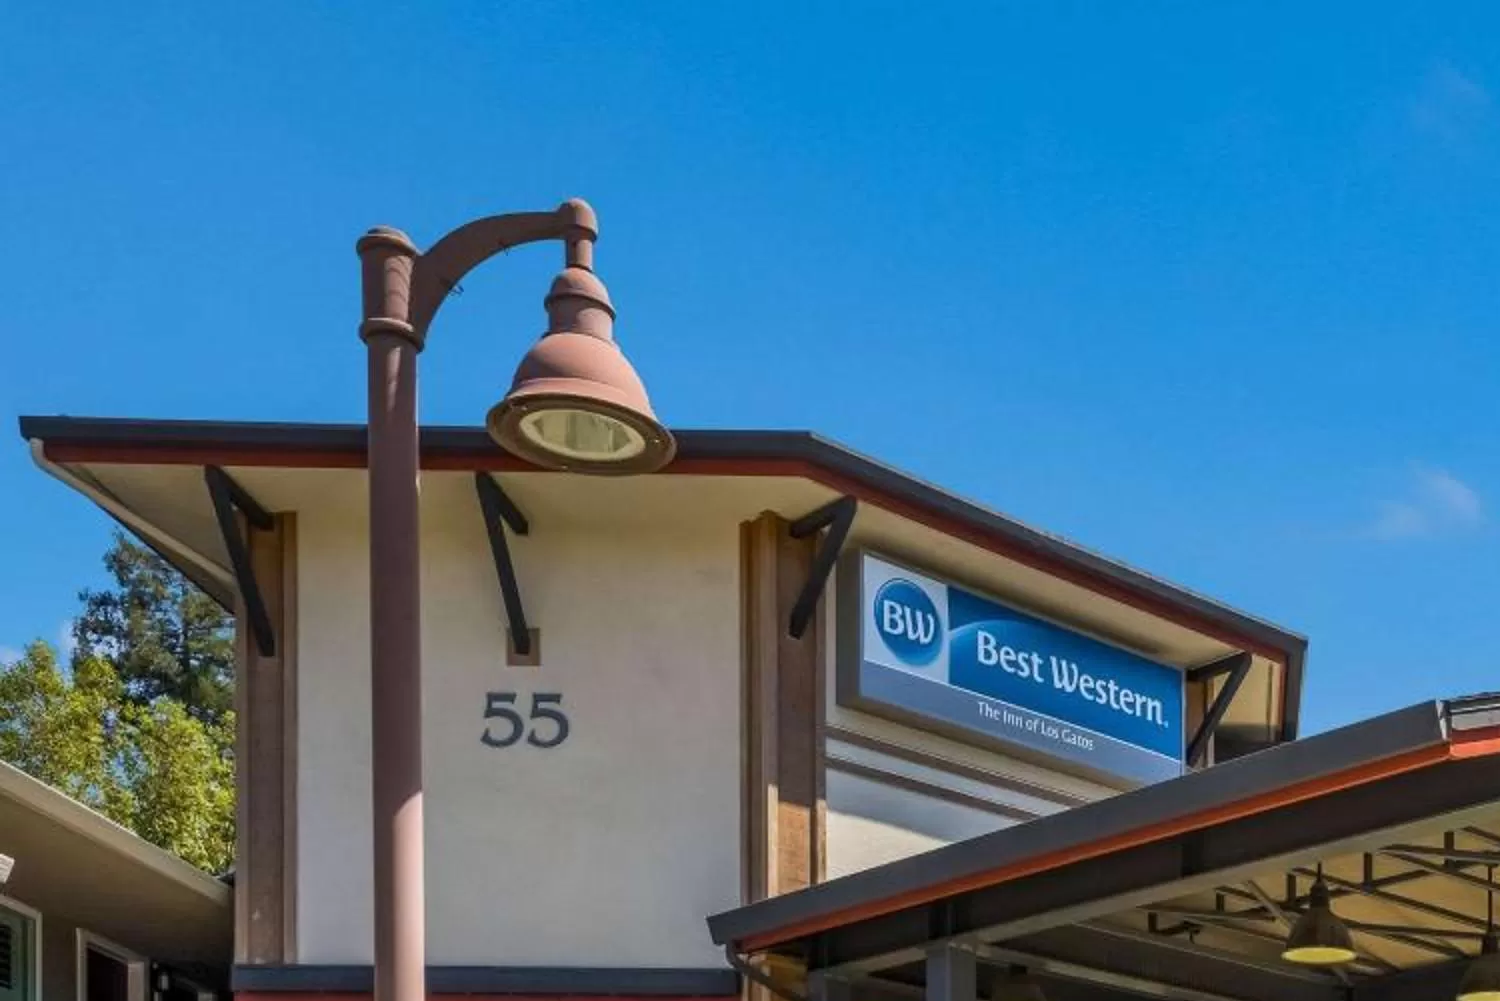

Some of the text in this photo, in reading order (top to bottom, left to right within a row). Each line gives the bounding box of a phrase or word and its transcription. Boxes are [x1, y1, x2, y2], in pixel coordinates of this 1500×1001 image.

[882, 600, 936, 645] BW
[976, 630, 1045, 684] Best
[480, 692, 569, 749] 55
[977, 701, 1094, 751] The Inn of Los Gatos
